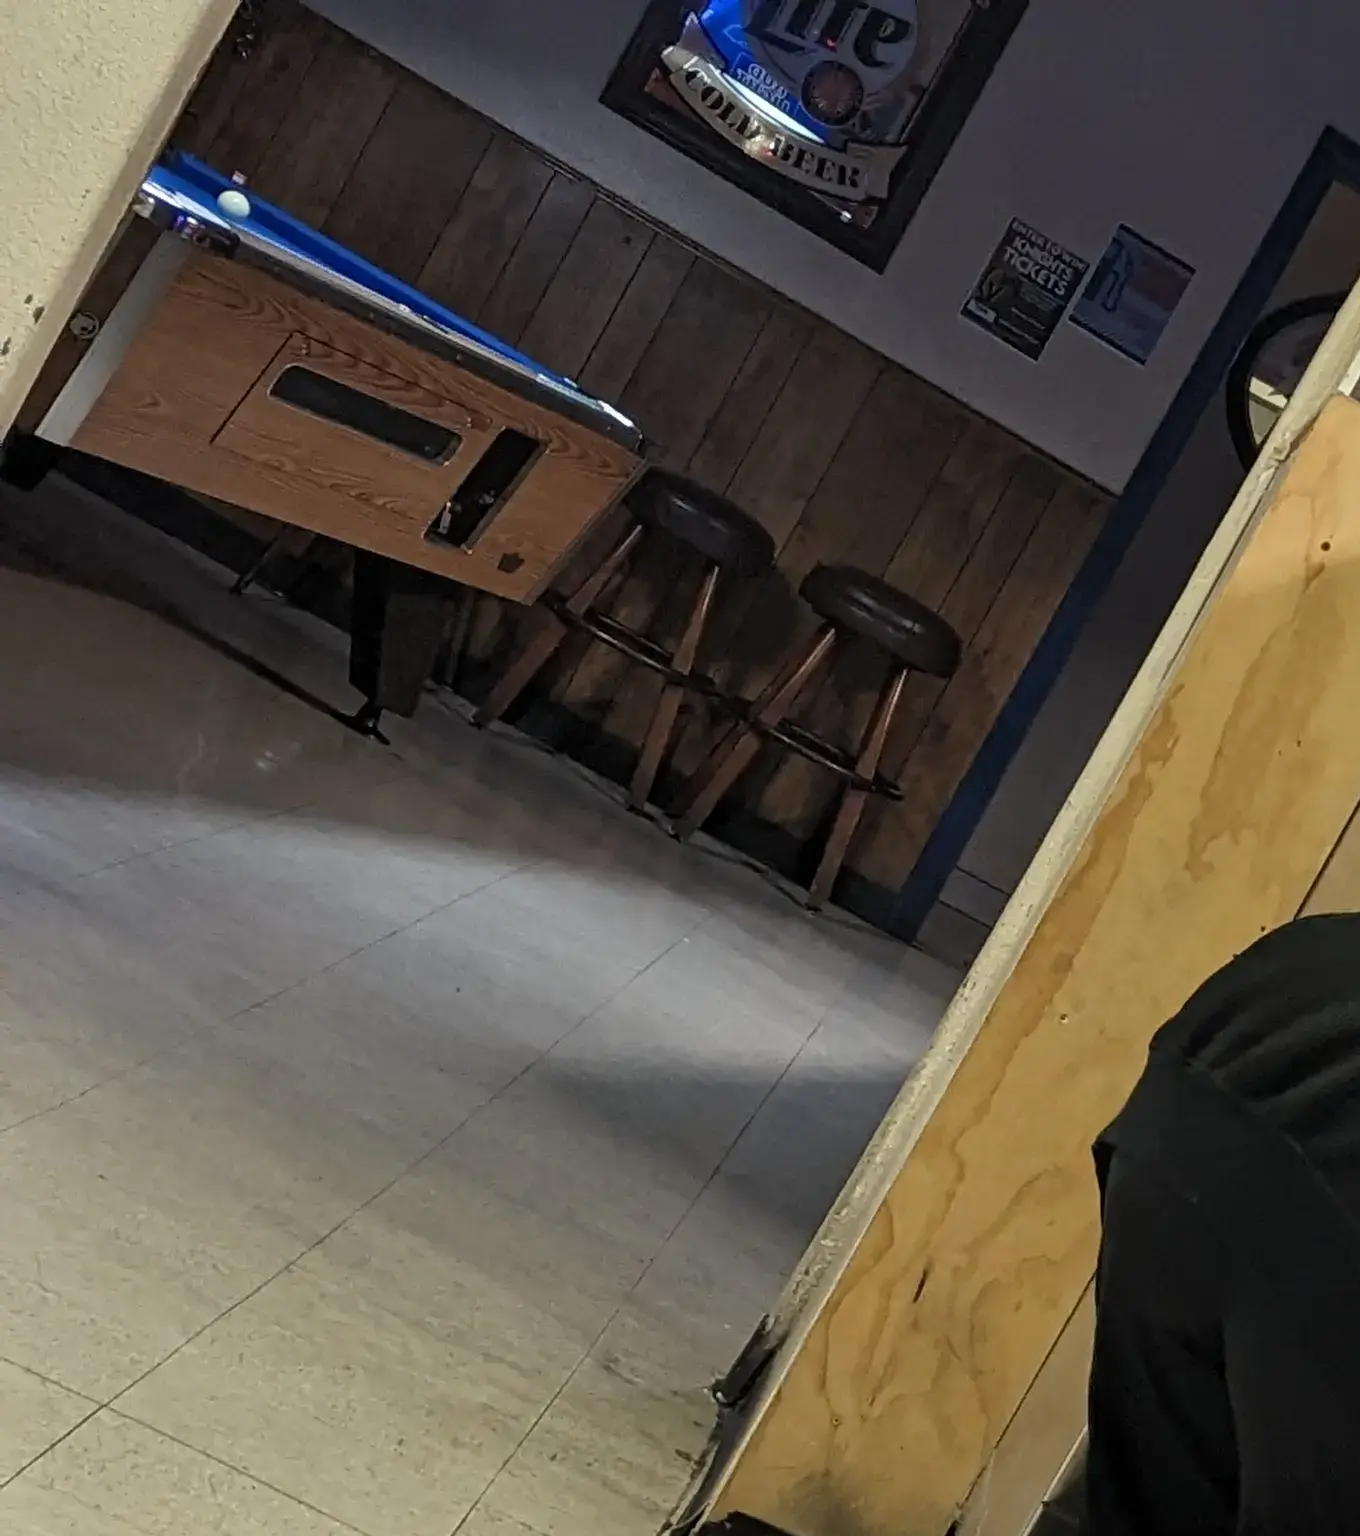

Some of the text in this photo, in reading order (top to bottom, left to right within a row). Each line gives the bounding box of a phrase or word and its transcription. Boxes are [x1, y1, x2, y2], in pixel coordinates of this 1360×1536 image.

[685, 66, 764, 141] COLD
[769, 133, 861, 189] BEER
[998, 246, 1070, 296] TICKETS
[1009, 235, 1077, 282] KNIGHTS
